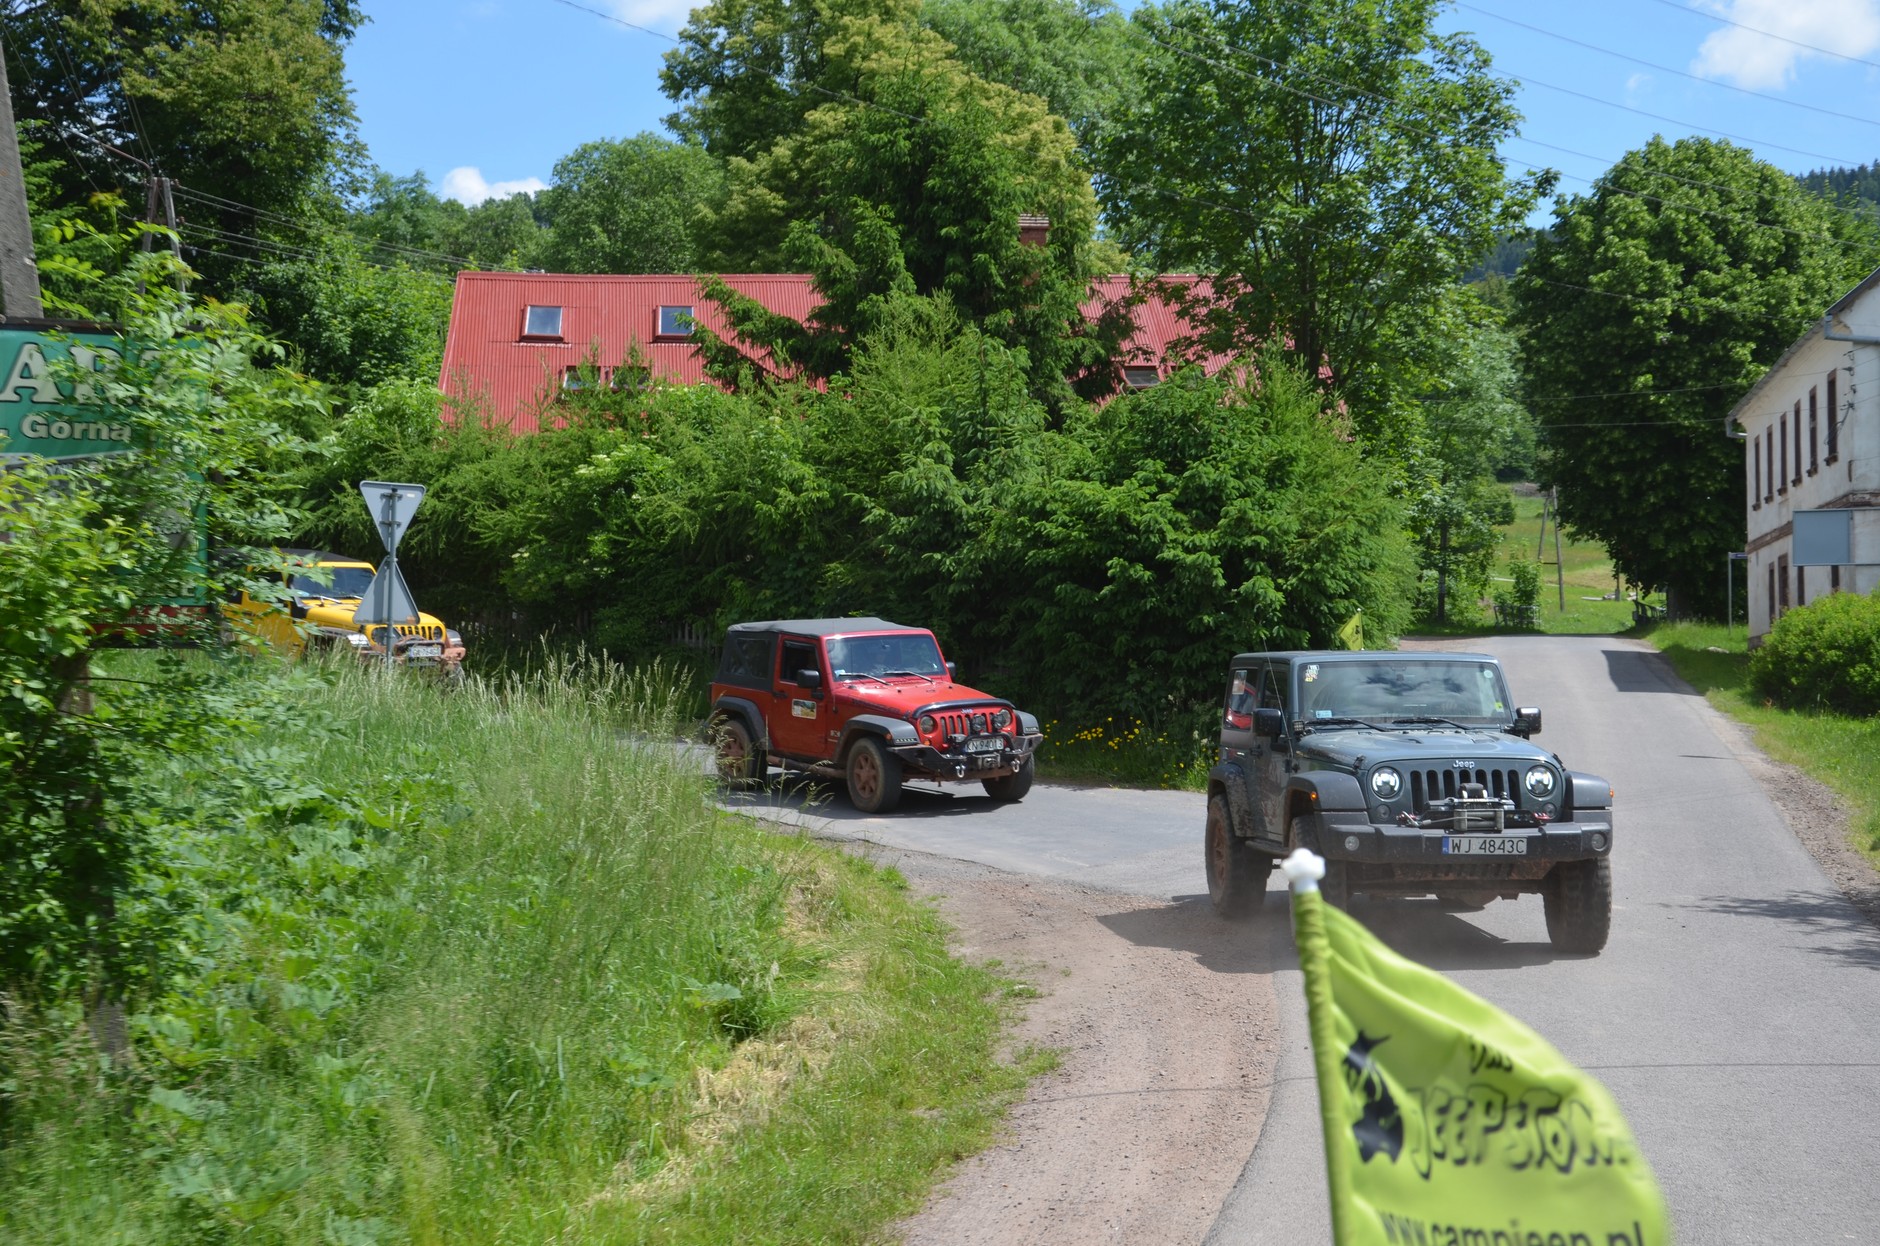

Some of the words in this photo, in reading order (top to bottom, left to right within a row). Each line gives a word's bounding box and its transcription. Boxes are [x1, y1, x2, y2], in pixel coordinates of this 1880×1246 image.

[967, 741, 978, 751] KN
[1453, 760, 1475, 769] Jeep
[1452, 839, 1471, 853] WJ
[1479, 839, 1524, 853] 4843C
[1377, 1208, 1643, 1246] wwwcamjeel
